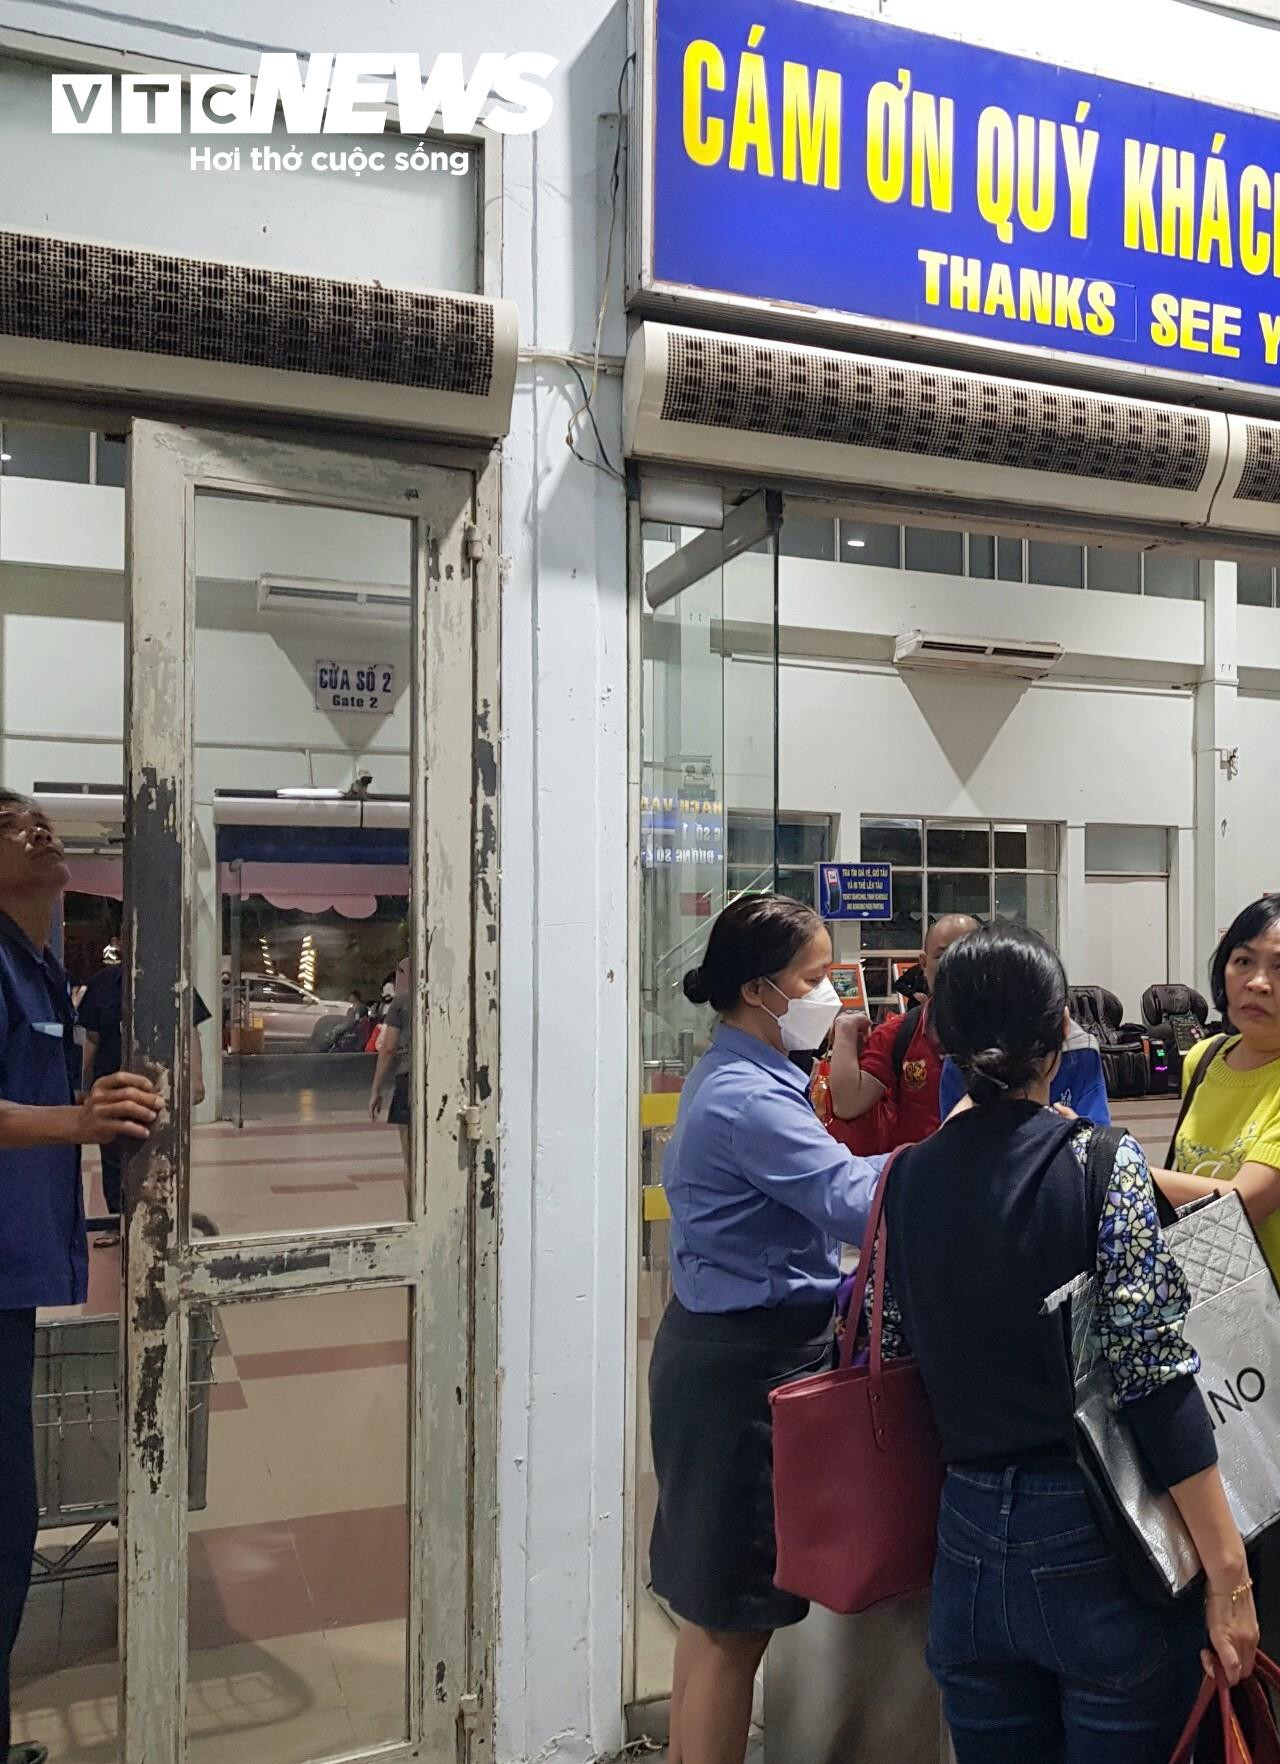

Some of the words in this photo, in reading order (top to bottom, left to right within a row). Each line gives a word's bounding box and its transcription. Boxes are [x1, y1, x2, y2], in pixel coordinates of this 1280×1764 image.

[682, 24, 842, 191] CÁM
[865, 68, 955, 214] ƠN
[976, 101, 1099, 244] QUÝ
[917, 249, 1116, 337] THANKS
[1150, 293, 1242, 359] SEE
[319, 662, 351, 691] CỬA
[356, 664, 377, 692] SỐ
[382, 672, 392, 693] 2
[332, 694, 365, 708] Gate
[369, 696, 379, 709] 2
